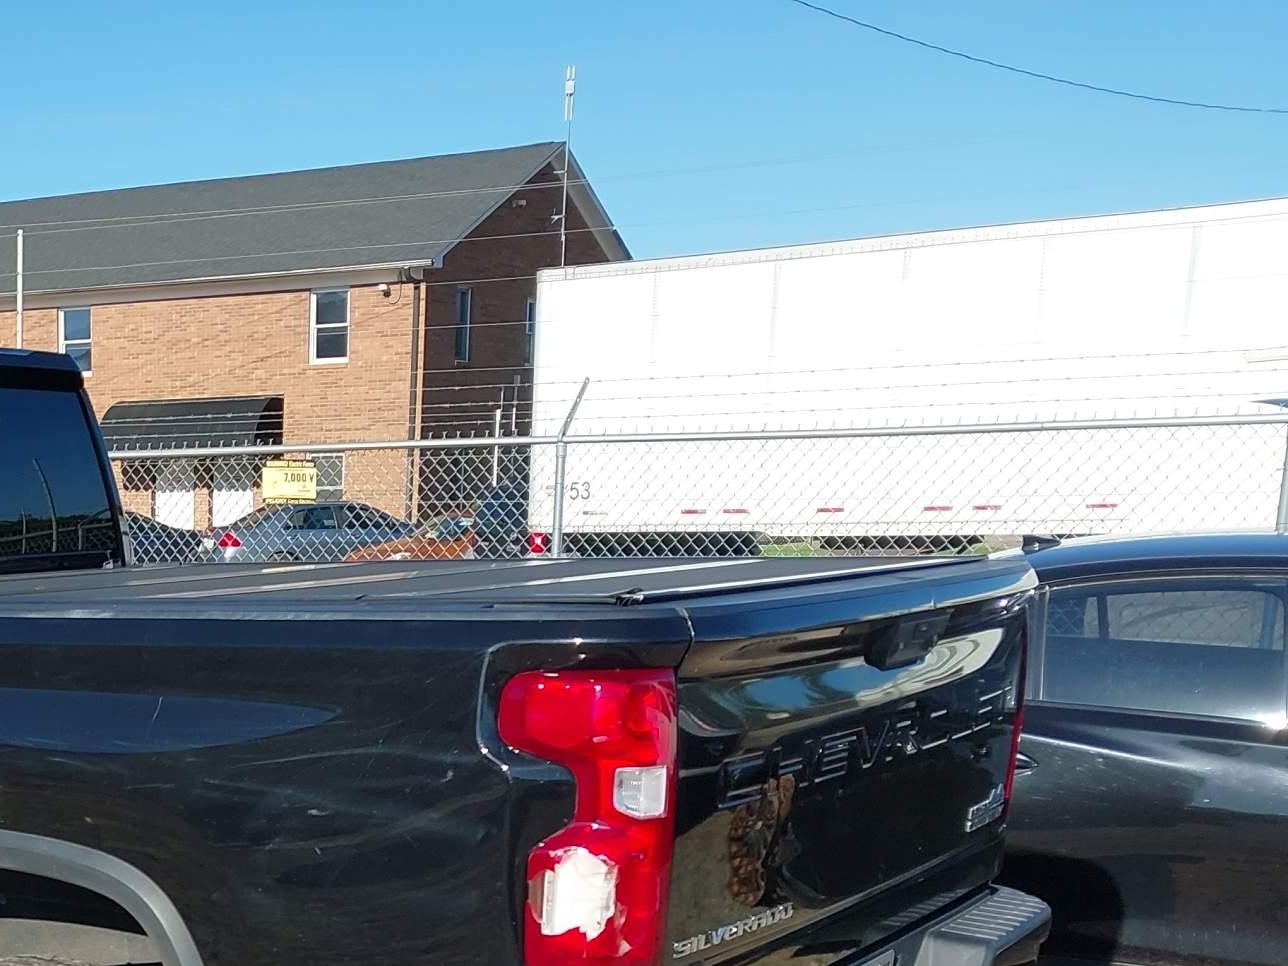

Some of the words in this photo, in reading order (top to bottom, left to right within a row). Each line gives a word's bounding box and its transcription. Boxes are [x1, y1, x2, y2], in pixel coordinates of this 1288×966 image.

[284, 472, 307, 483] 7,000
[309, 472, 315, 483] V
[672, 902, 794, 958] SILVERADO
